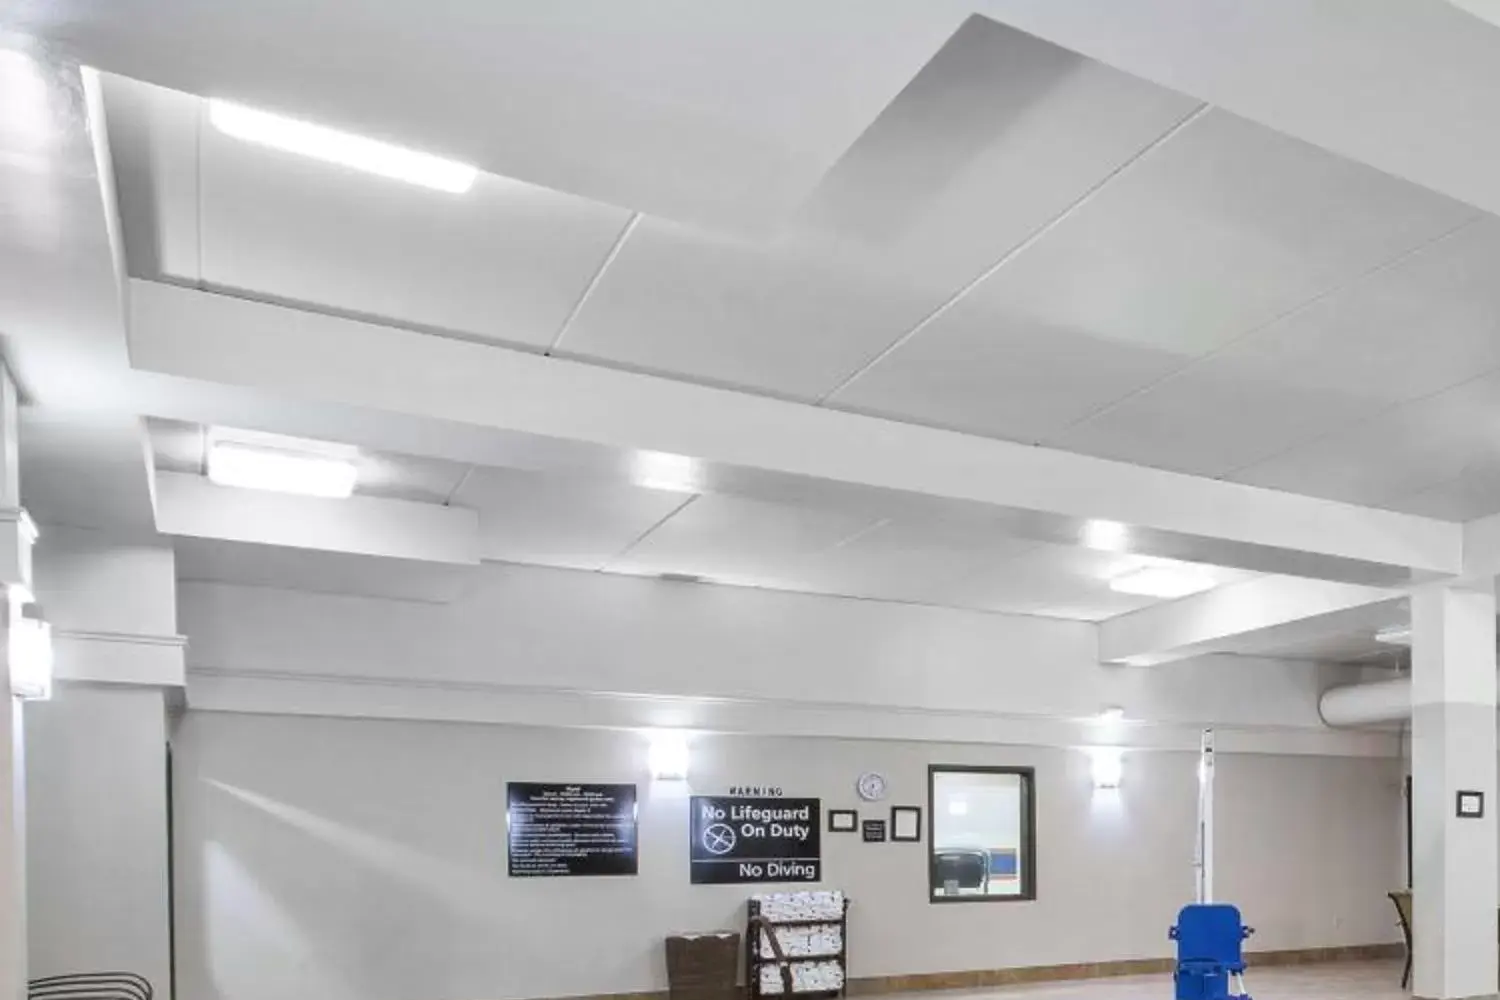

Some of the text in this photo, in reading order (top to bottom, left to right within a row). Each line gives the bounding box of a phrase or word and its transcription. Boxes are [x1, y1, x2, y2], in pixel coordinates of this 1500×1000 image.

[729, 785, 783, 797] WARNING
[702, 805, 809, 823] No Lifeguard
[741, 823, 809, 841] On Duty
[740, 862, 815, 879] No Diving
